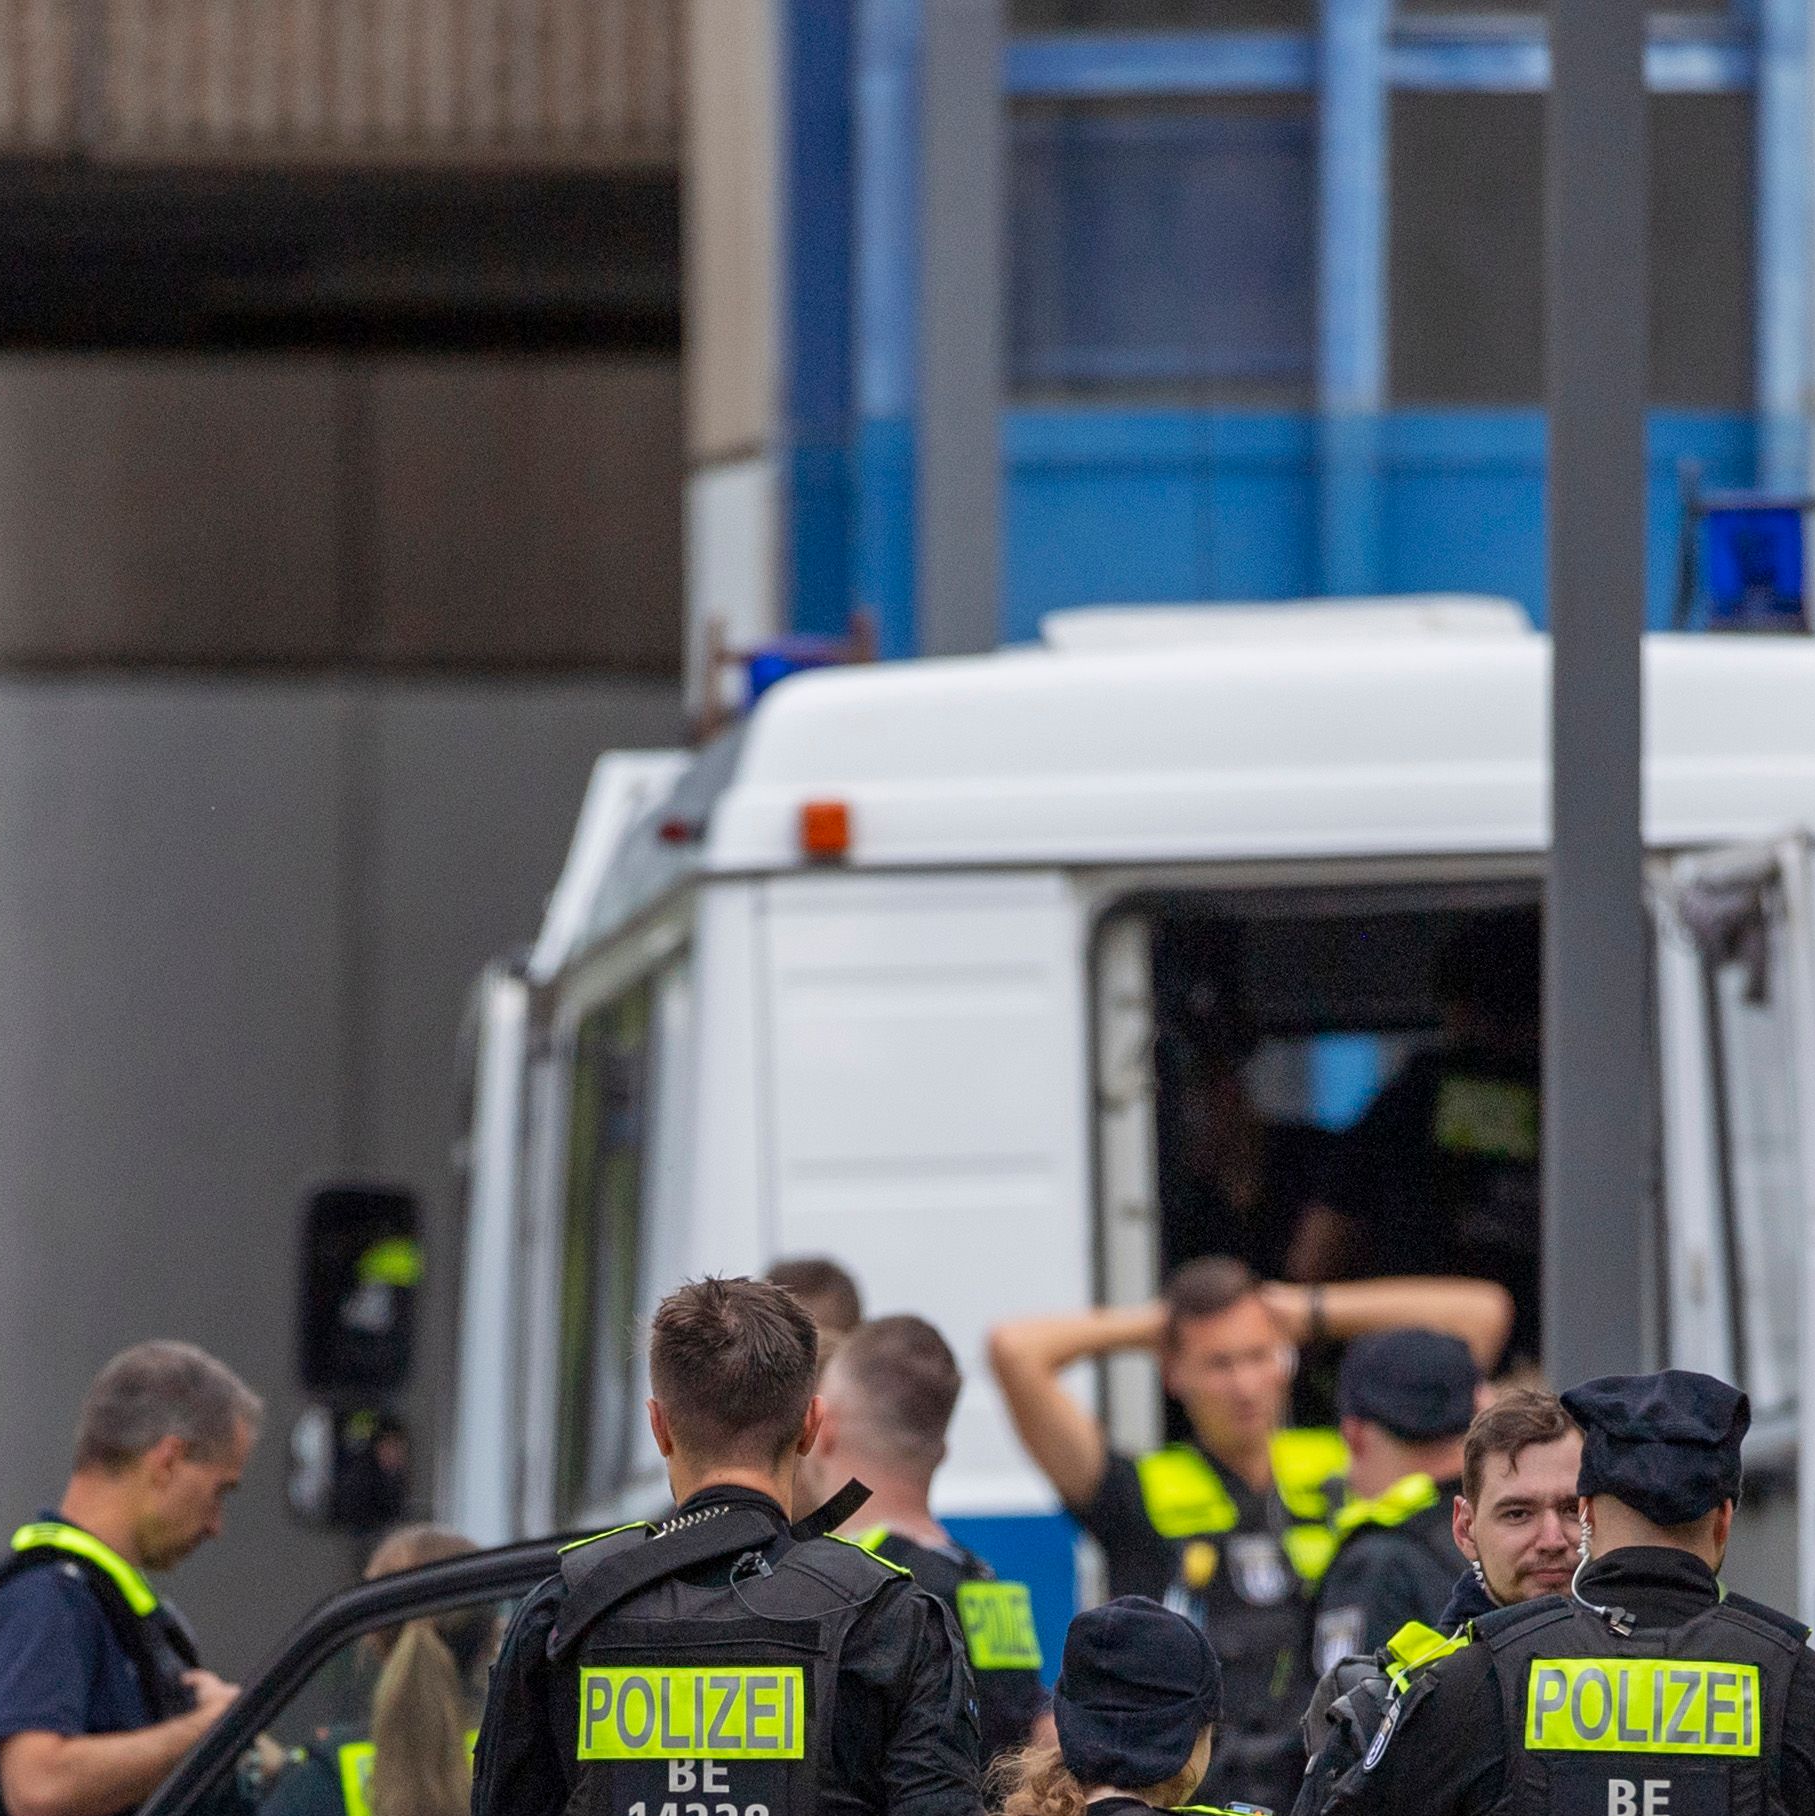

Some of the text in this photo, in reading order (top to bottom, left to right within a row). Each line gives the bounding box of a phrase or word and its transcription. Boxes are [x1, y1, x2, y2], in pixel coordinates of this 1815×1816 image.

[584, 1675, 795, 1750] POLIZEI
[1534, 1667, 1753, 1747] POLIZEI
[668, 1759, 730, 1794] BE
